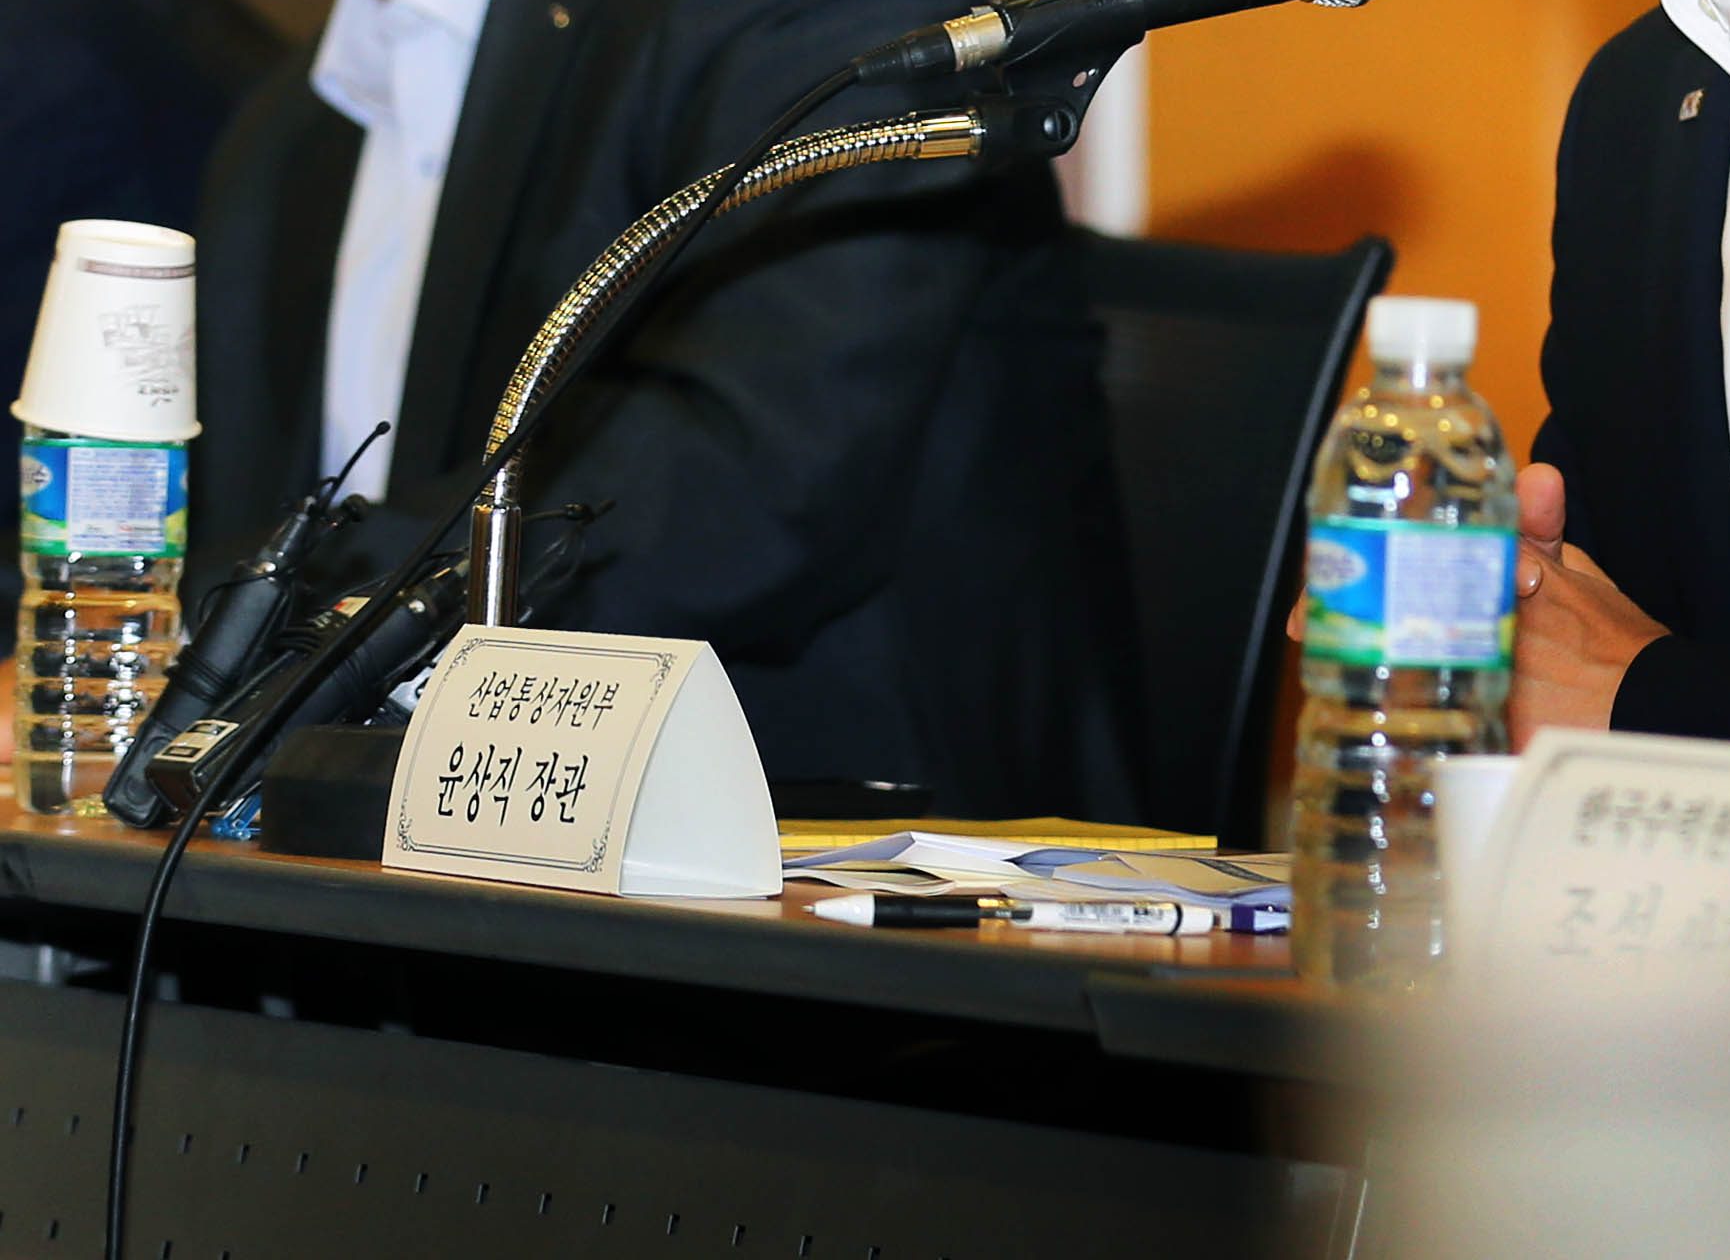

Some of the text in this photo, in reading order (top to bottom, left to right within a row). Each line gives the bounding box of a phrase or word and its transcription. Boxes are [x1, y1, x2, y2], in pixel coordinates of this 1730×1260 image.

[469, 671, 620, 730] 산업통상자원부
[437, 741, 589, 827] 윤상직 장관
